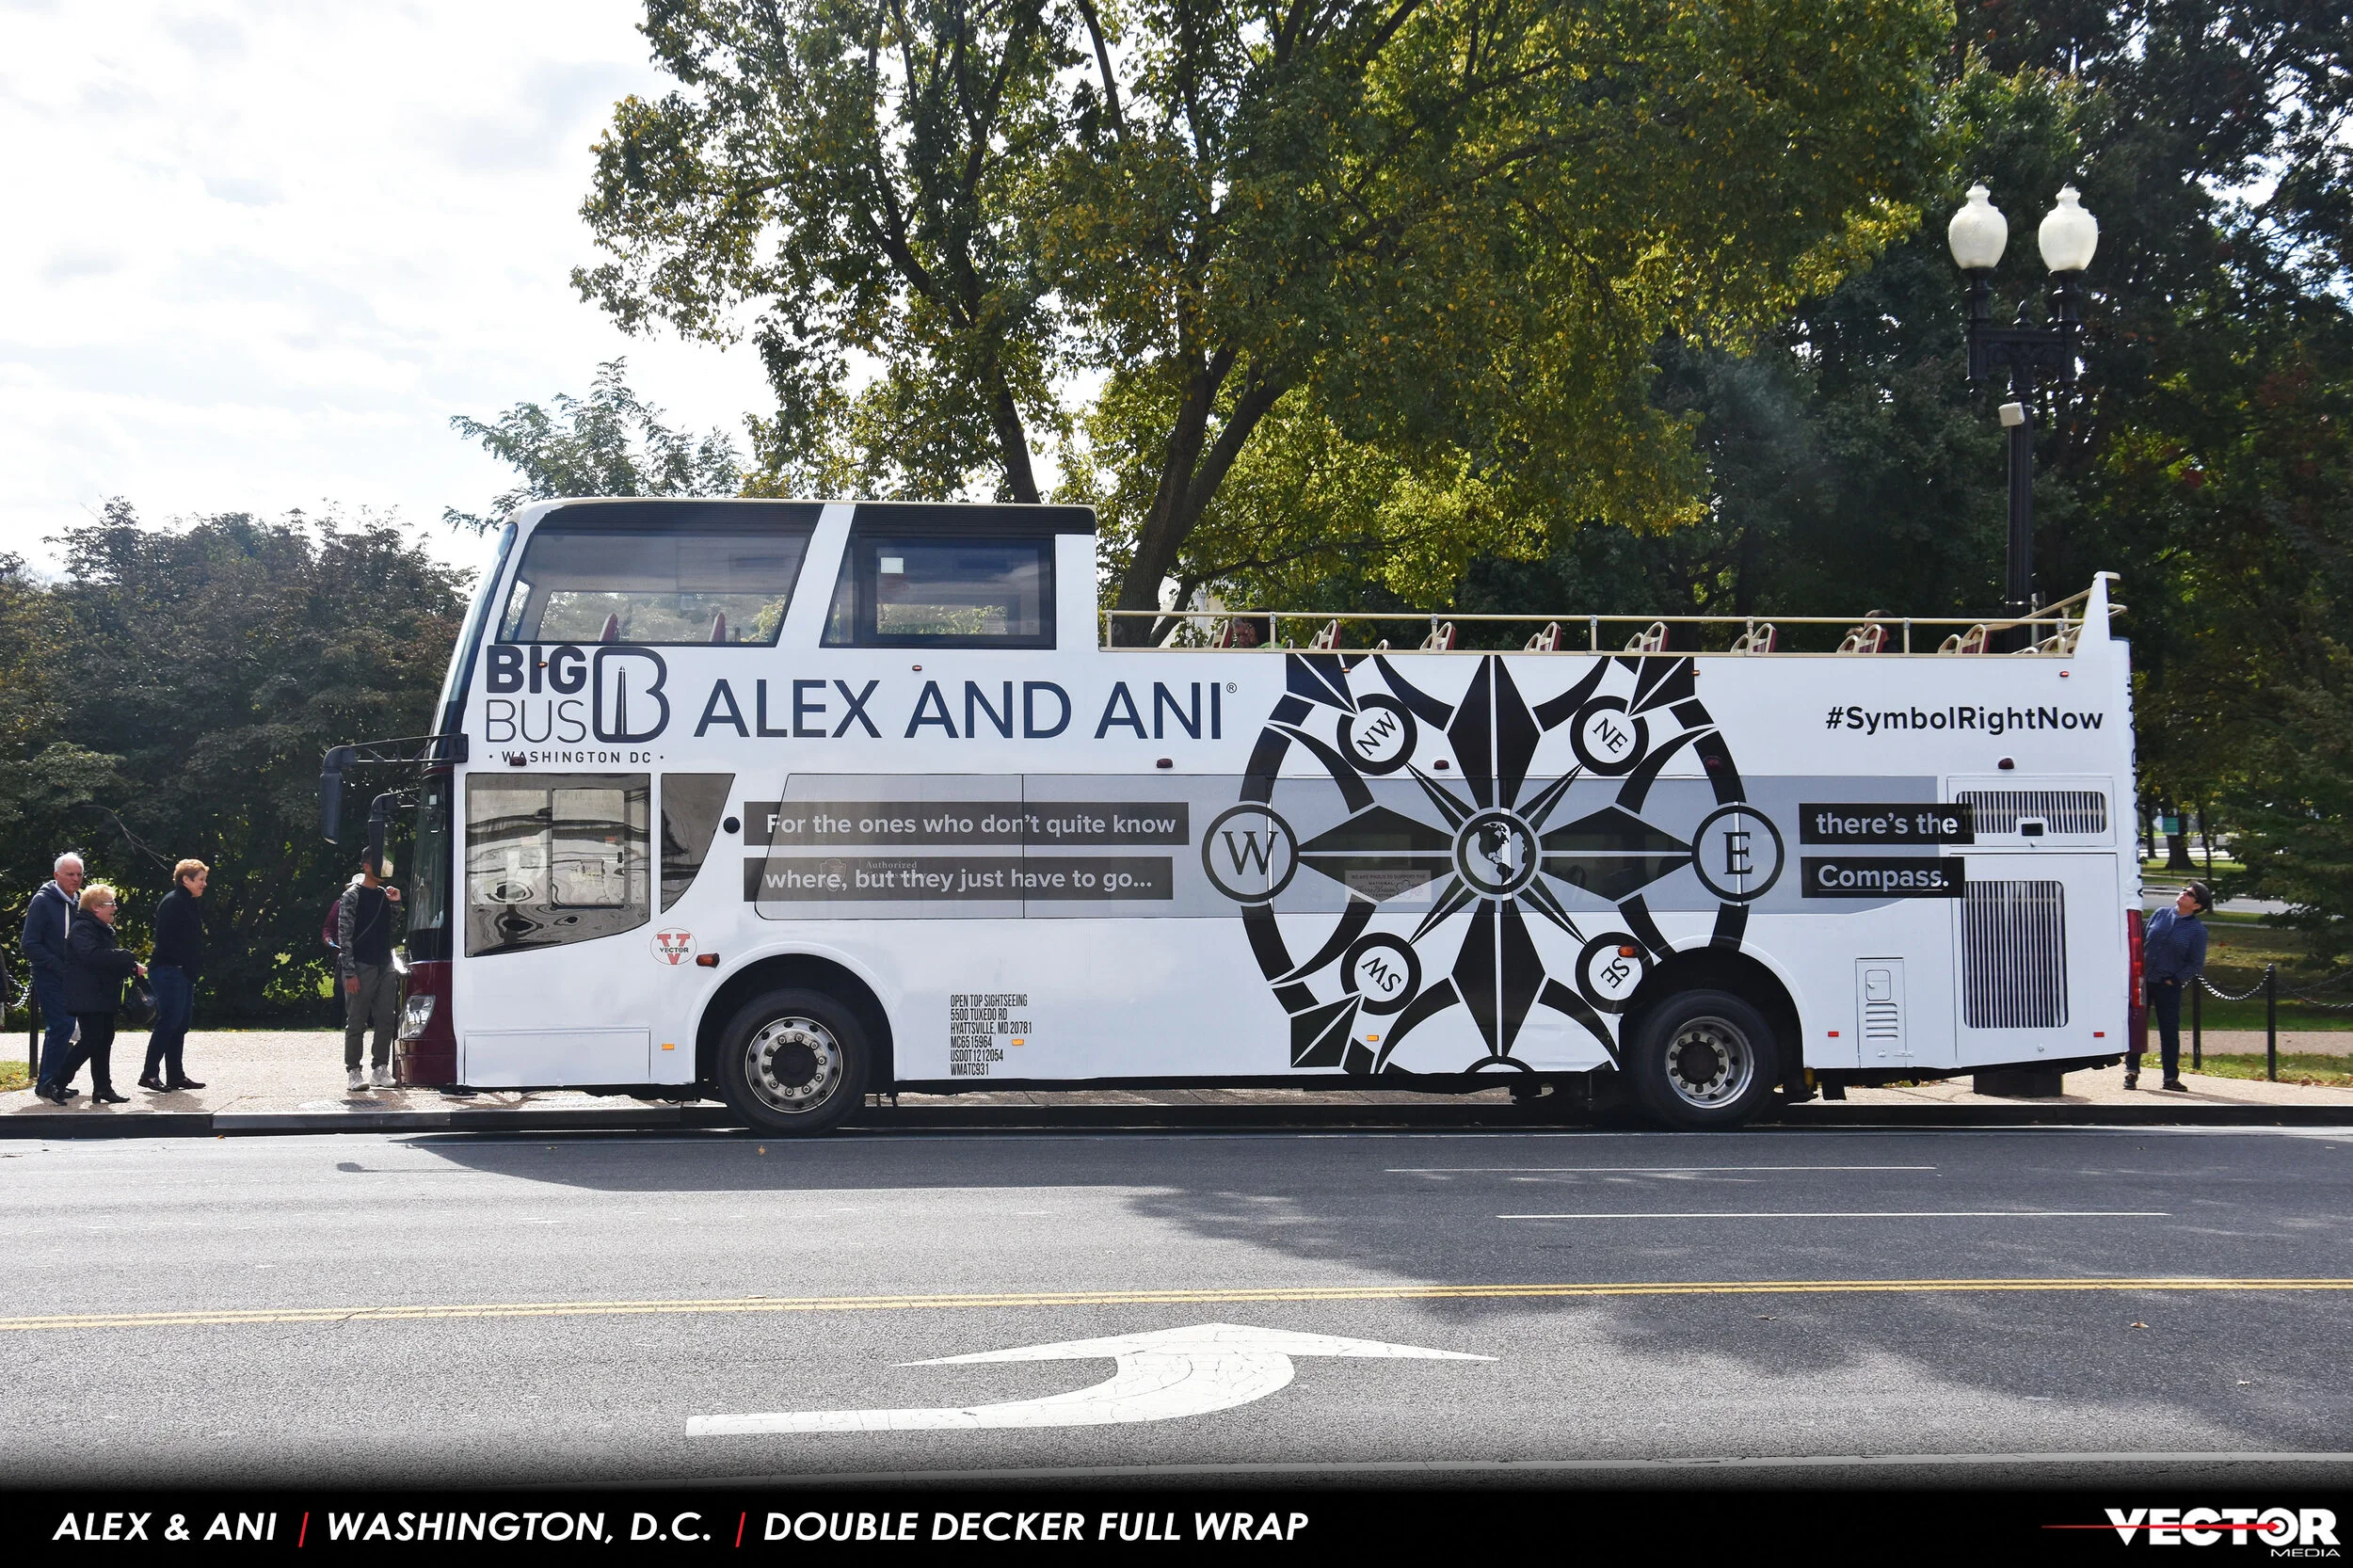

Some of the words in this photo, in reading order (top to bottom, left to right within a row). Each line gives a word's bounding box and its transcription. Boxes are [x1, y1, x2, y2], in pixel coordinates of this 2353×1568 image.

[487, 645, 586, 694] BIG
[486, 699, 586, 743] BUS
[694, 679, 883, 739] ALEX
[904, 680, 1072, 739] AND
[1826, 707, 2104, 735] #SymbolRightNow
[1355, 712, 1397, 757] NW
[1593, 717, 1628, 754] NE
[630, 751, 651, 763] DC
[767, 814, 807, 834] For
[812, 813, 852, 834] the
[859, 818, 917, 834] ones
[923, 813, 974, 834] who
[1046, 813, 1106, 839] quite
[1113, 813, 1176, 834] know
[1916, 813, 1959, 835] the
[867, 860, 918, 869] Authorized
[1223, 831, 1278, 875] W
[1723, 832, 1753, 875] E
[764, 869, 848, 891] where,
[856, 869, 895, 888] but
[902, 869, 953, 892] they
[958, 869, 1004, 892] just
[1011, 869, 1065, 888] have
[1073, 872, 1096, 888] to
[1818, 865, 1949, 888] Compass.
[1361, 956, 1402, 993] SW
[1600, 956, 1630, 989] SE
[950, 994, 968, 1007] OPEN
[969, 994, 984, 1007] TOP
[984, 994, 1028, 1007] SIGHTSEEING
[950, 1008, 968, 1021] 5500
[969, 1008, 997, 1021] TUXEDO
[998, 1007, 1008, 1020] RD
[950, 1022, 997, 1035] HYATTSVILLE,
[997, 1022, 1008, 1034] MD
[1010, 1021, 1032, 1033] 20781
[950, 1035, 993, 1048] MC6515964
[950, 1049, 1004, 1062] USDOT1212054
[950, 1063, 989, 1076] WMATC931
